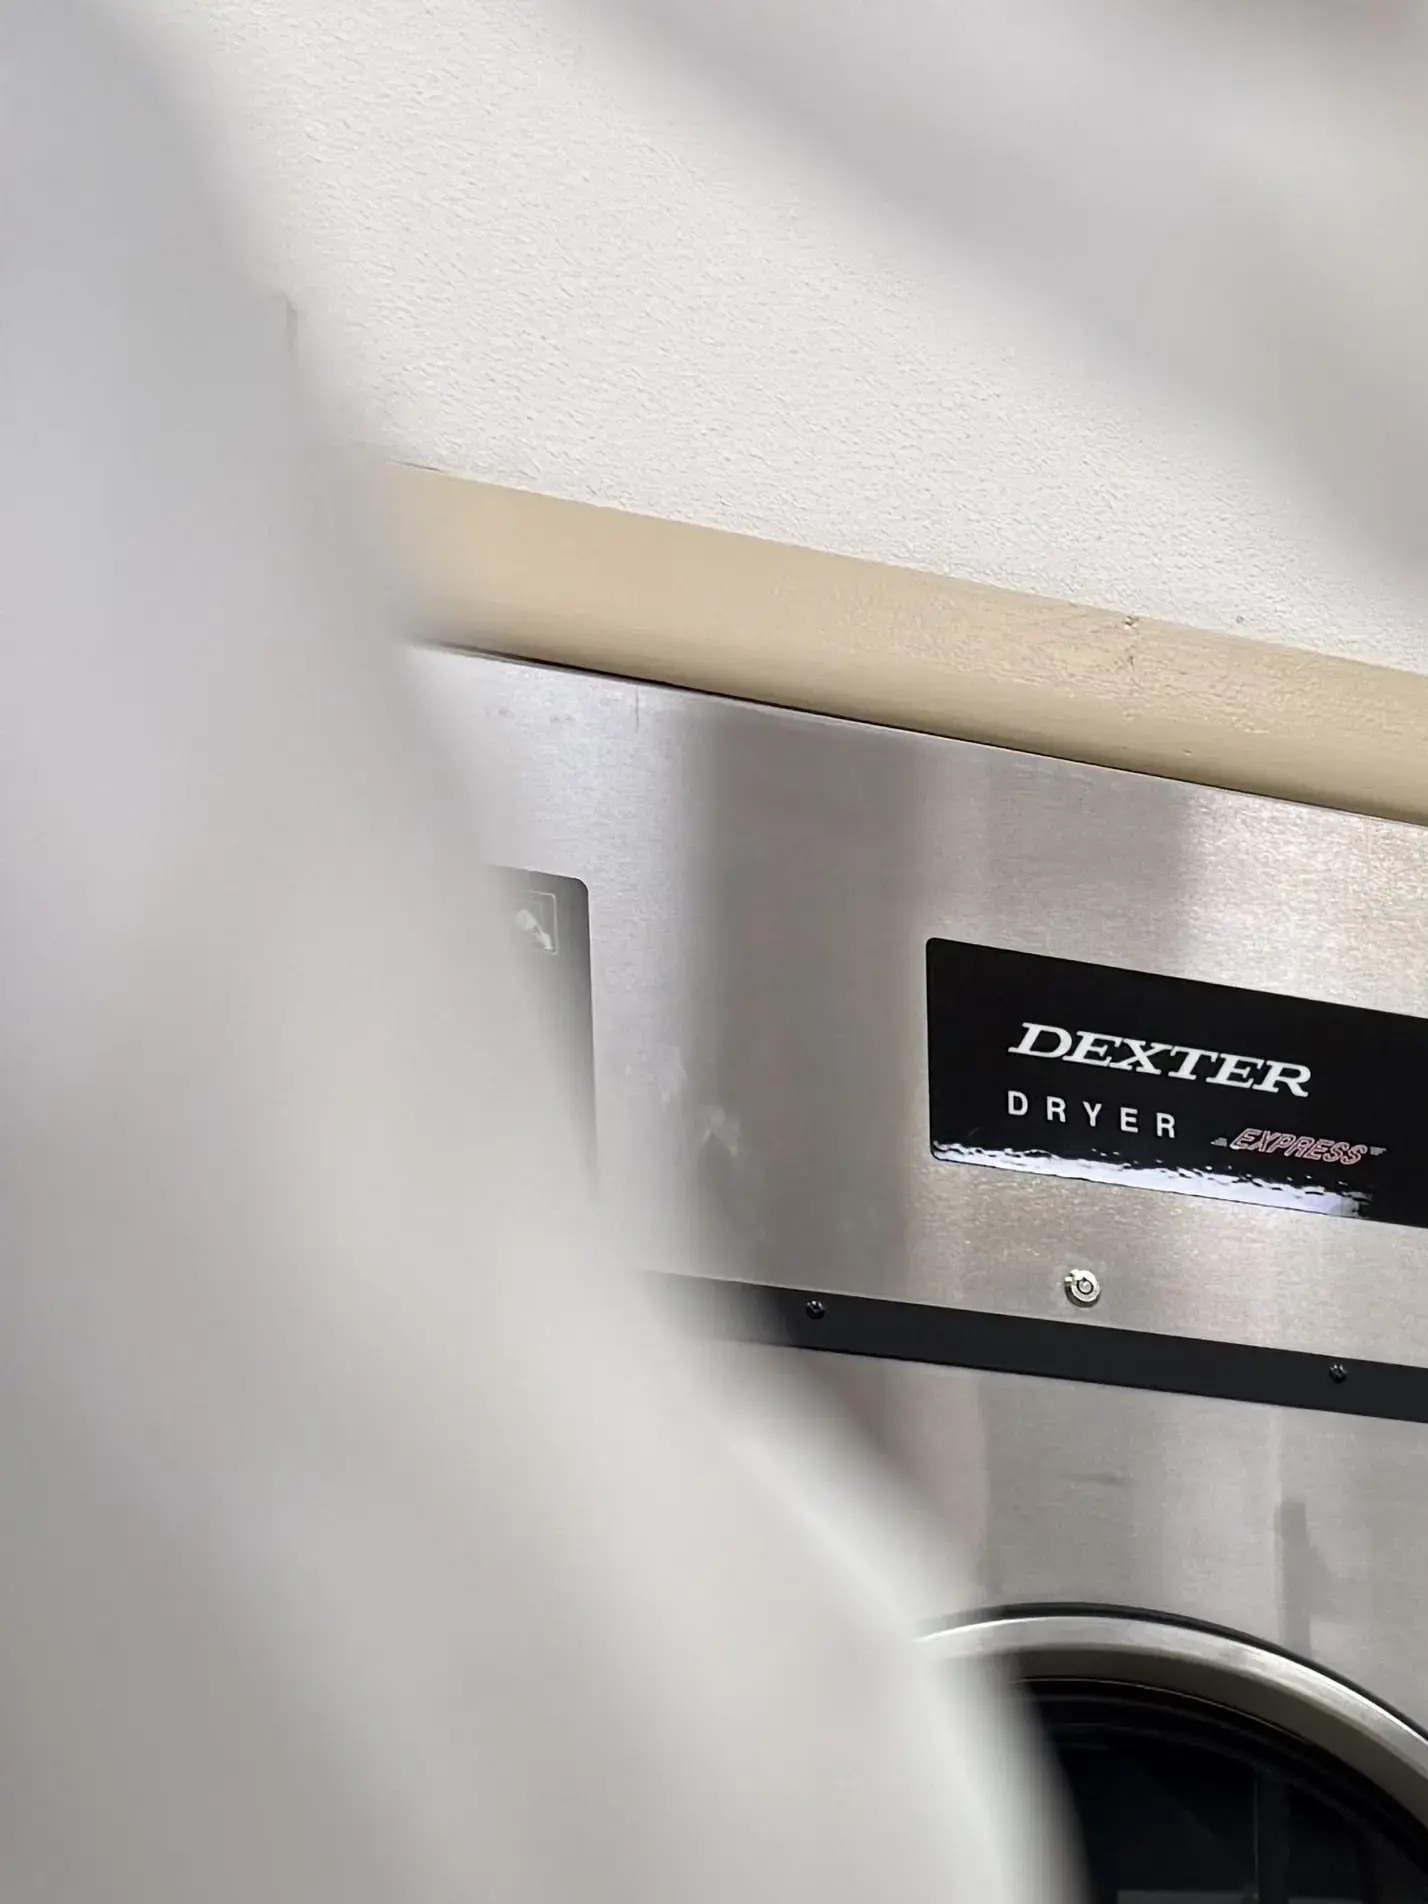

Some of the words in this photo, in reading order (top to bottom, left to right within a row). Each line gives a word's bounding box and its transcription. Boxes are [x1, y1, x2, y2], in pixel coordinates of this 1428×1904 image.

[1007, 1022, 1313, 1098] DEXTER
[1006, 1089, 1179, 1140] DRYER
[1230, 1127, 1370, 1167] EXPRESS
